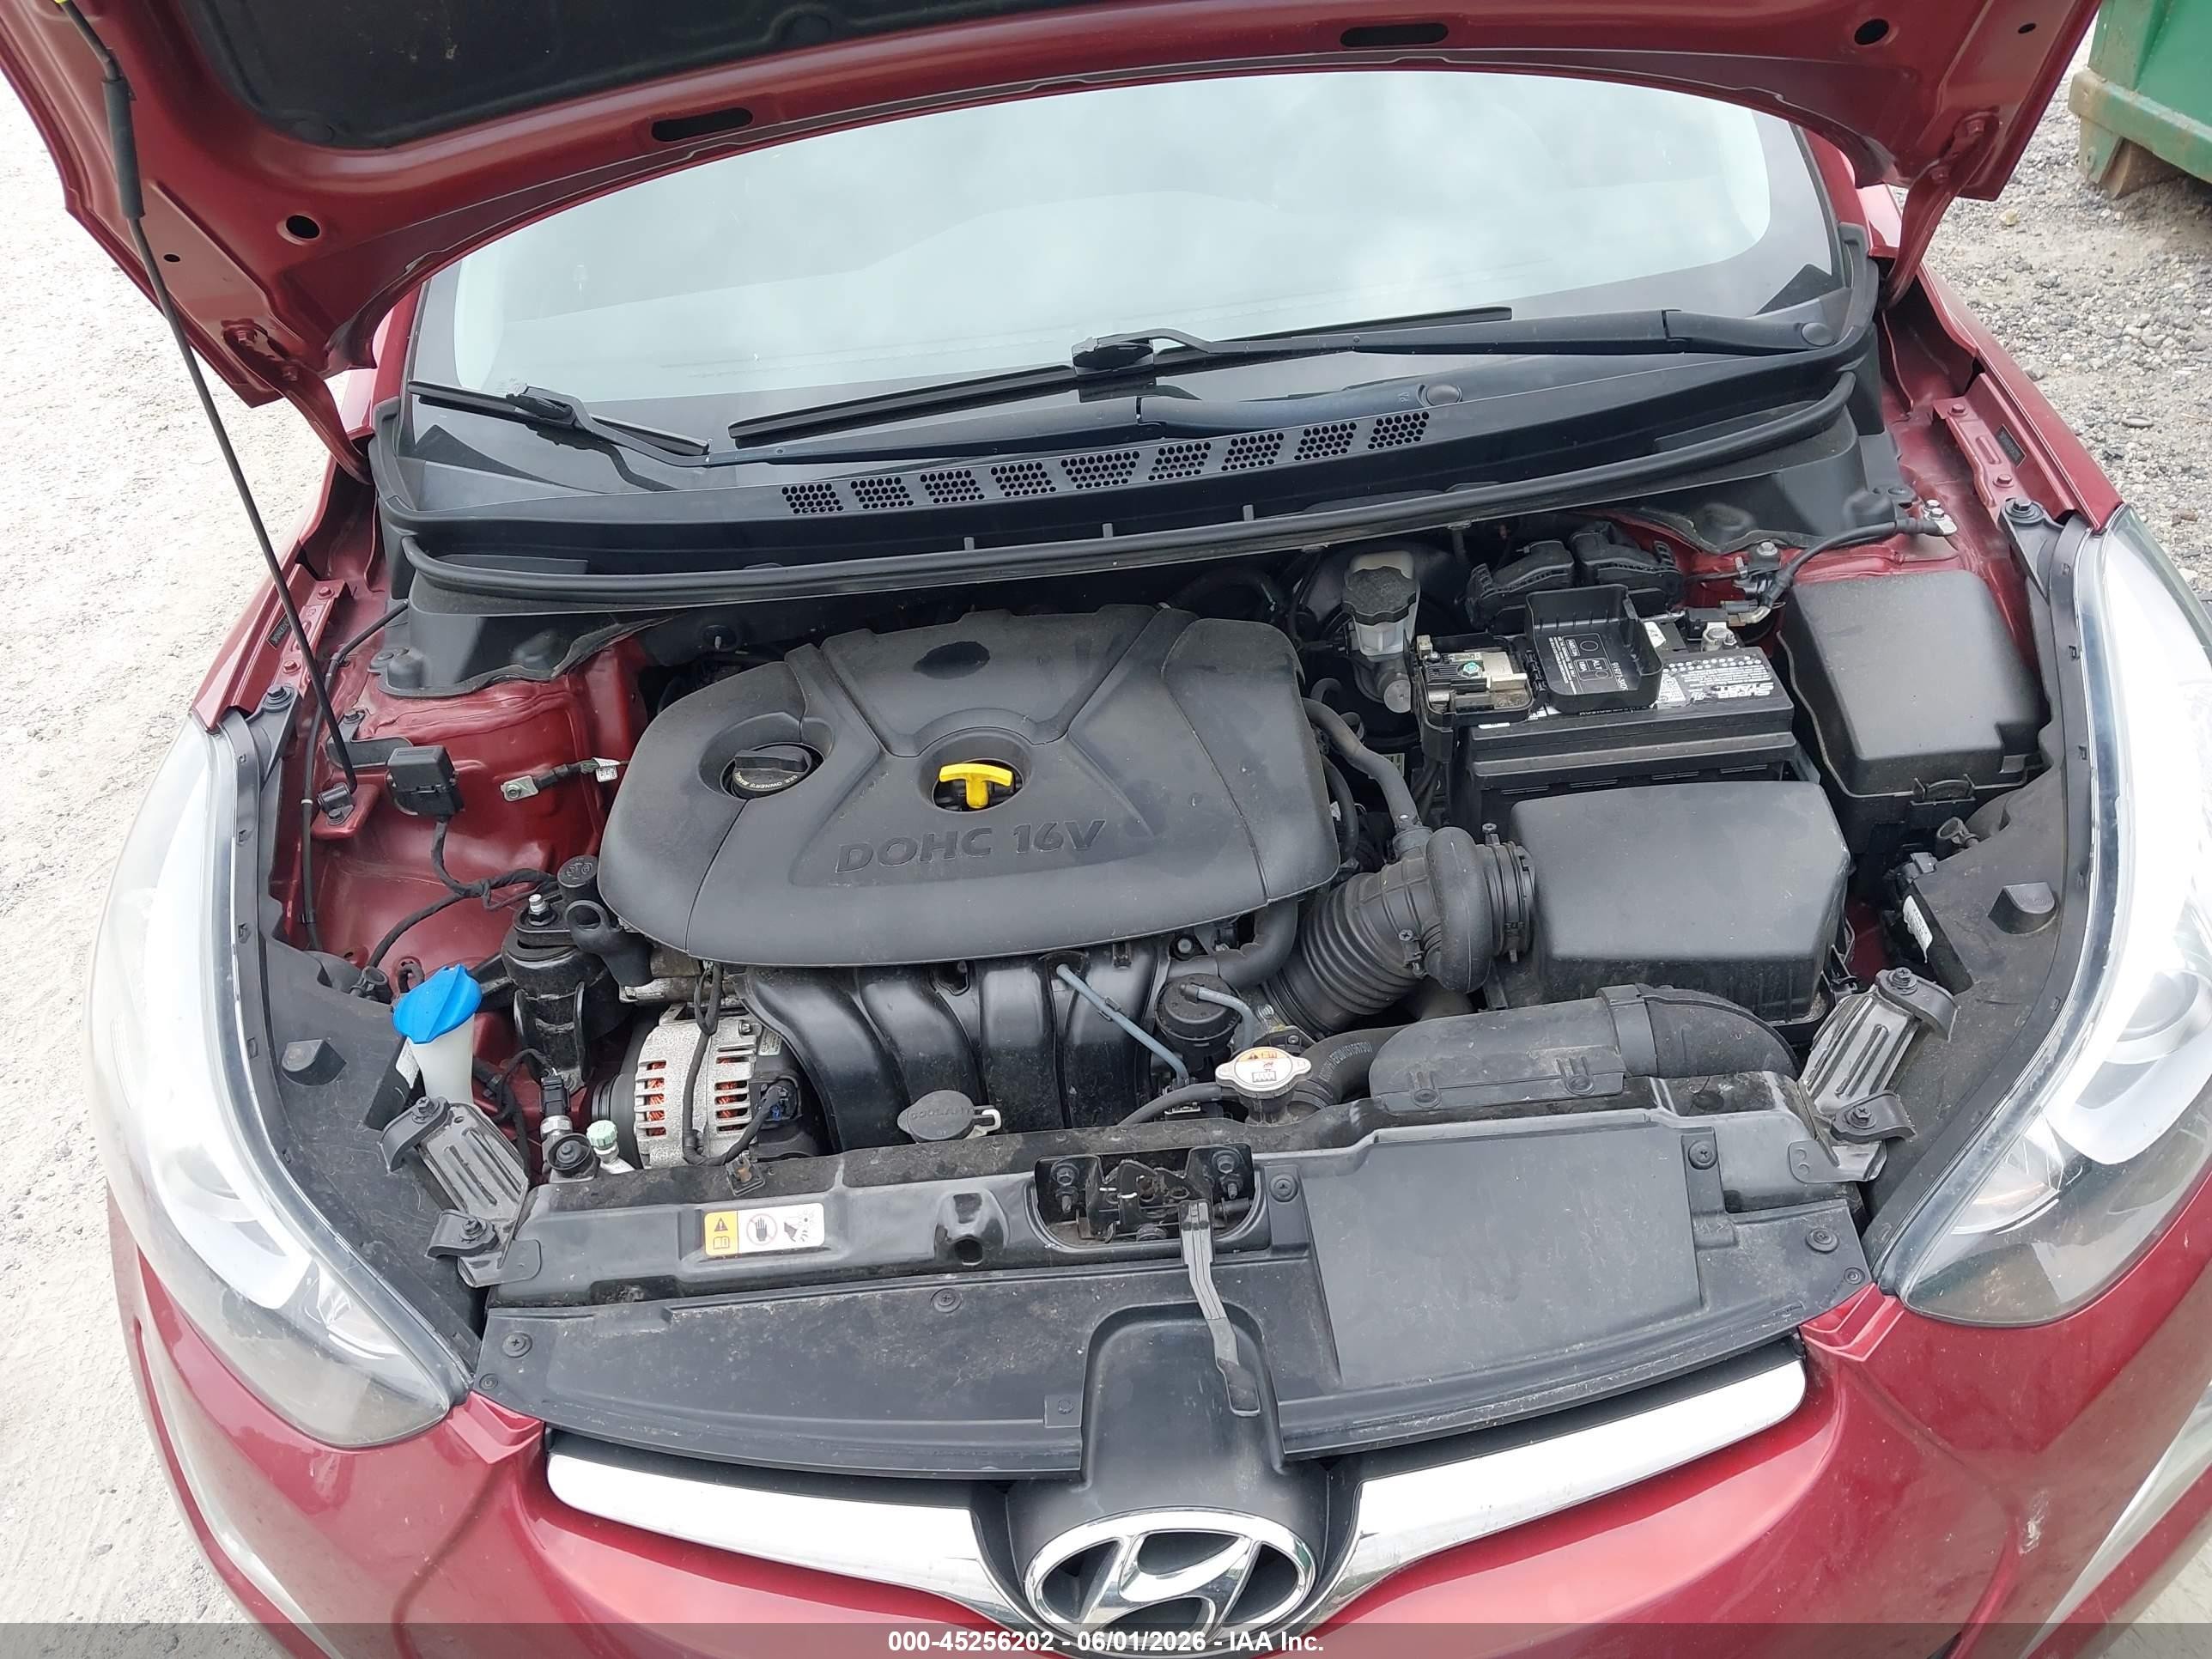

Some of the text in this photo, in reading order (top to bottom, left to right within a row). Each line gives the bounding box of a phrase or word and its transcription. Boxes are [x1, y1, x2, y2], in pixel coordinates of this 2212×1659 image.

[1593, 659, 1602, 670] ALT
[835, 819, 1106, 873] DOHC 16V
